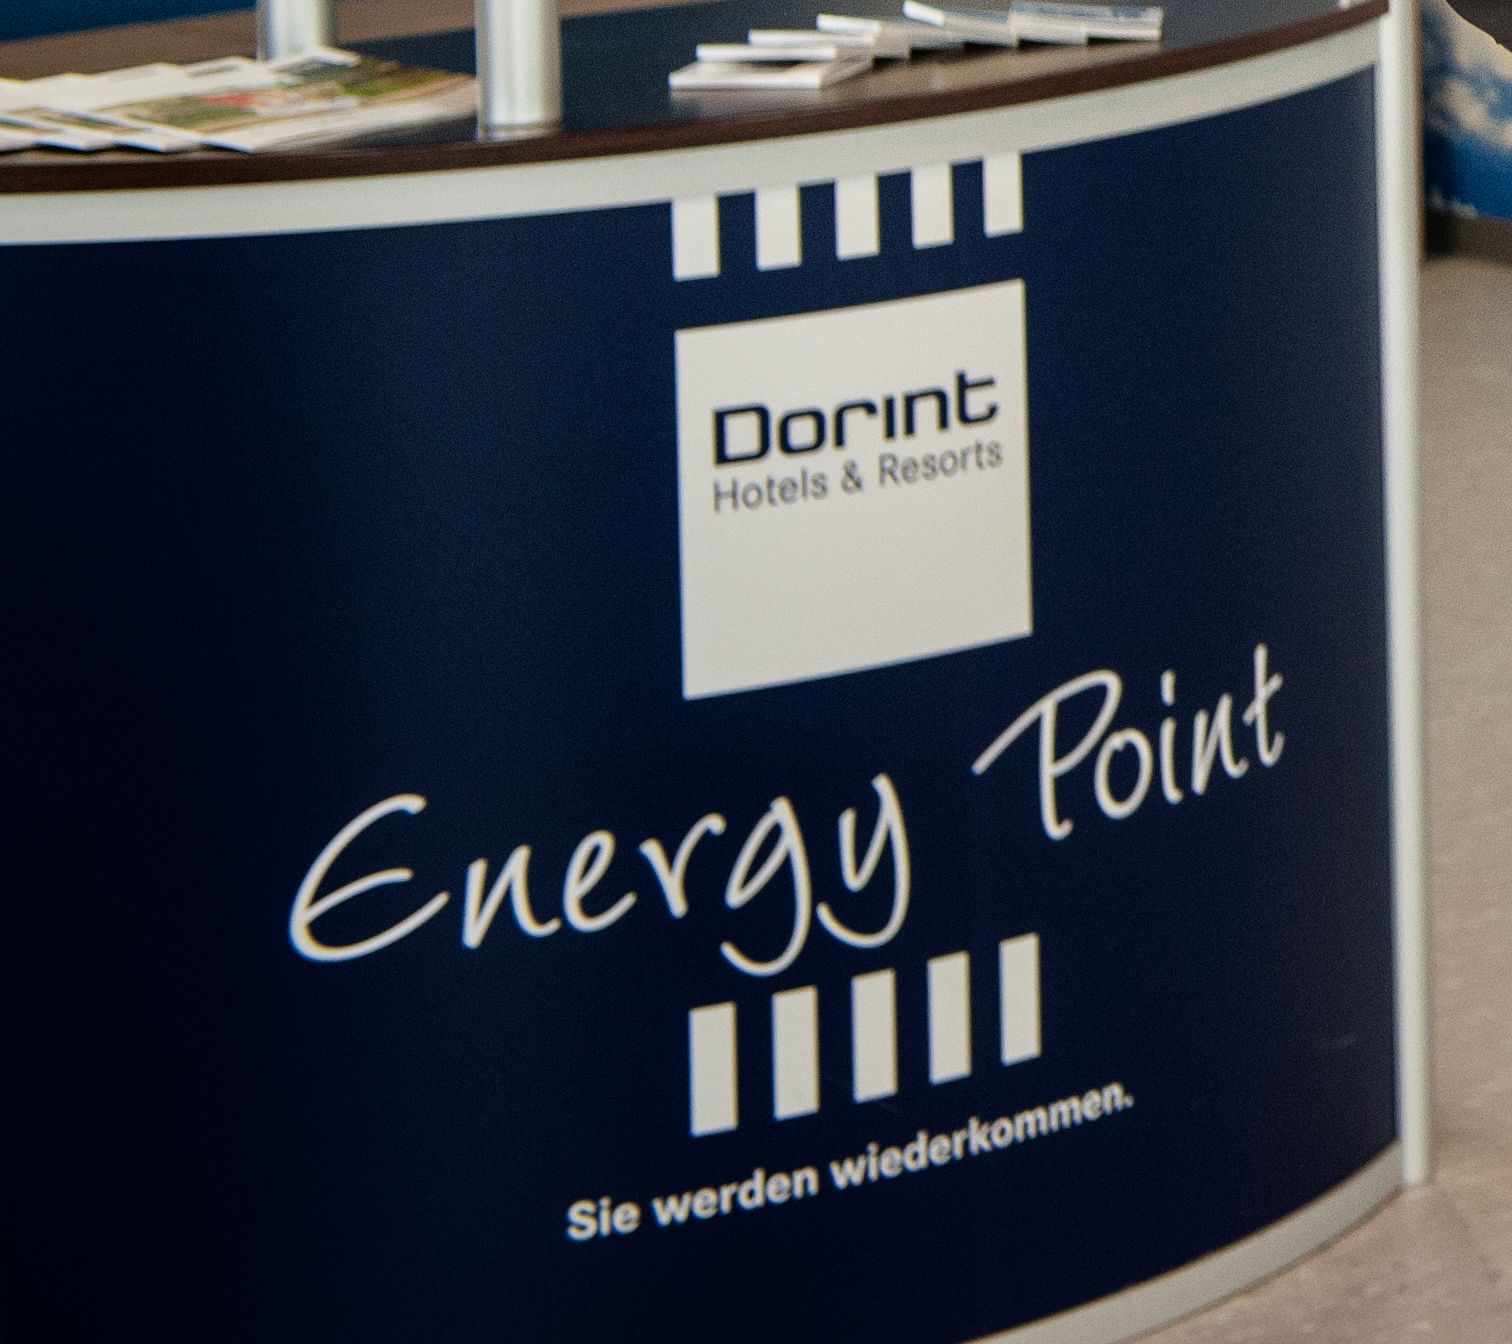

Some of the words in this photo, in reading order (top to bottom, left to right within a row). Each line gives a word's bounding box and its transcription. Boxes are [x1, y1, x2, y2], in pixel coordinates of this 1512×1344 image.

[711, 371, 999, 468] Dorint
[712, 469, 829, 513] Hotels
[840, 460, 863, 493] &
[878, 440, 1003, 485] Resorts
[289, 773, 911, 976] Energy
[972, 644, 1285, 840] Point
[566, 1196, 641, 1242] Sie
[651, 1166, 820, 1227] werden
[828, 1081, 1135, 1190] wiederkommen.
